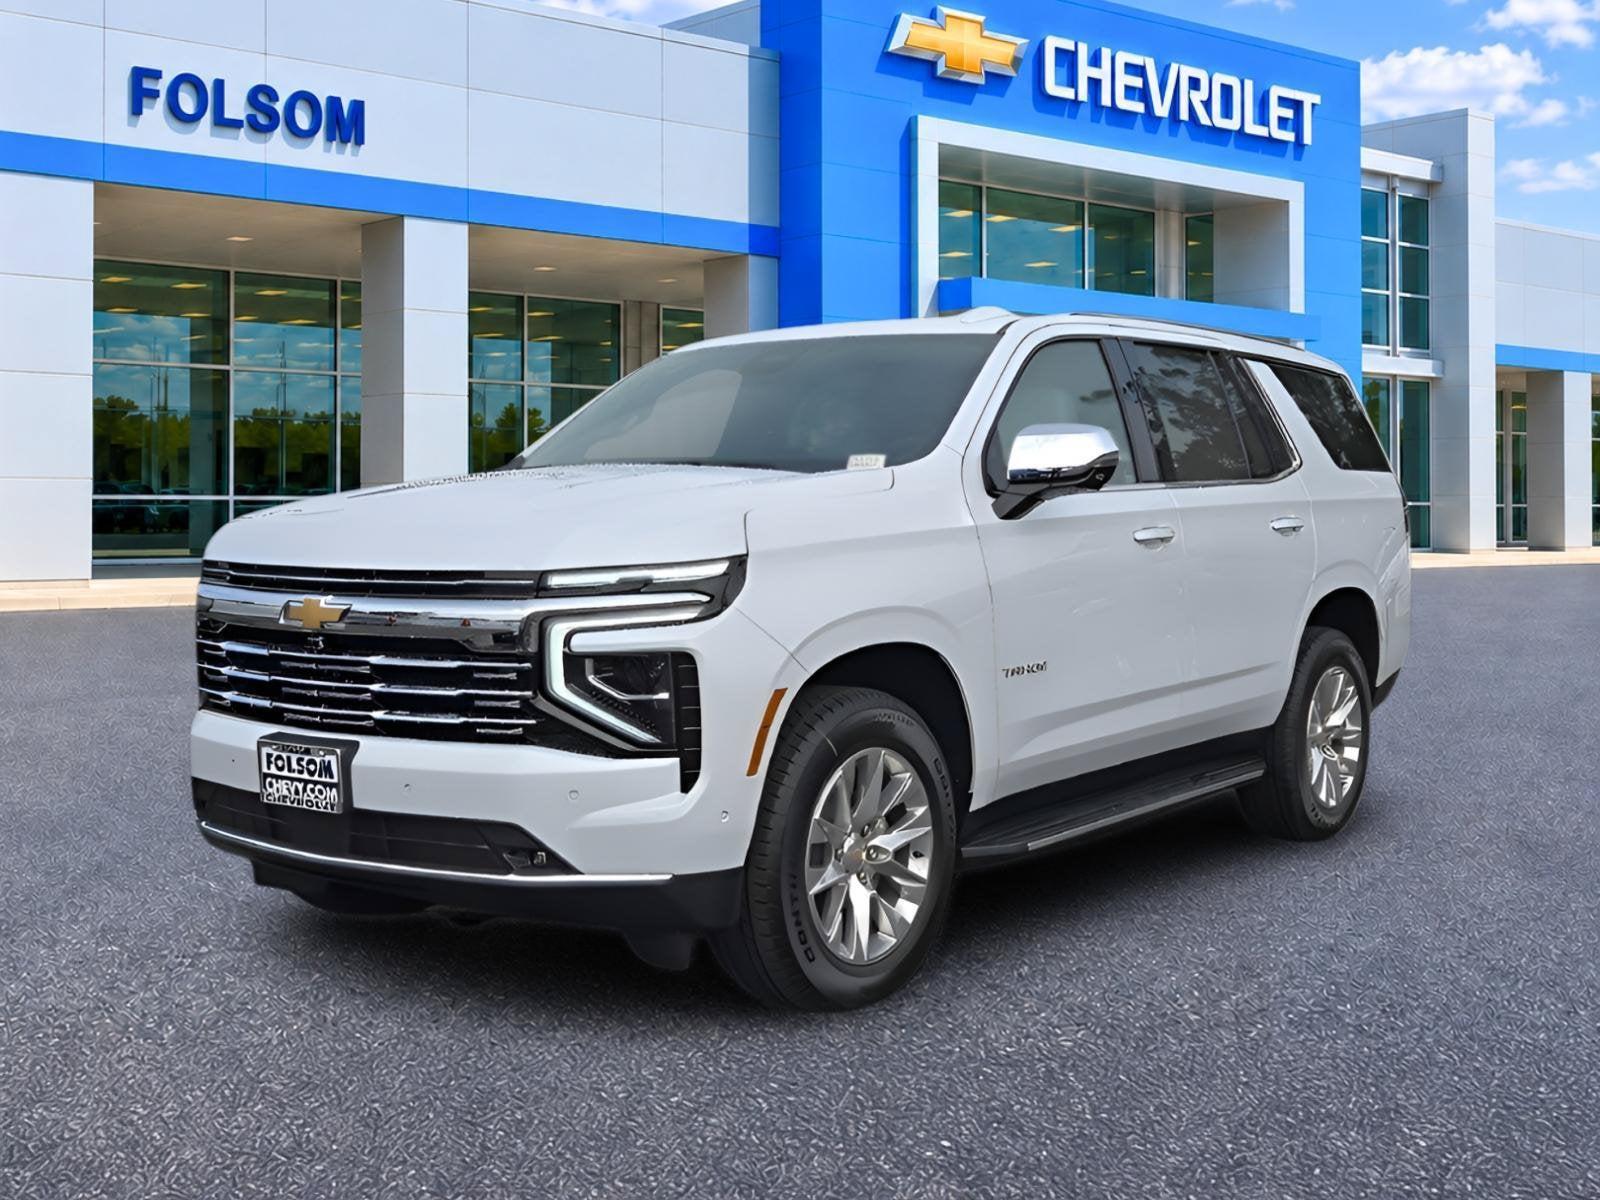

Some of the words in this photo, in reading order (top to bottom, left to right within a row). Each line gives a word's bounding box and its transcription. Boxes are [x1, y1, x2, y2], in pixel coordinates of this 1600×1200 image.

[131, 65, 365, 145] FOLSOM
[1044, 35, 1321, 145] CHEVROLET
[265, 752, 335, 779] FOLSOM
